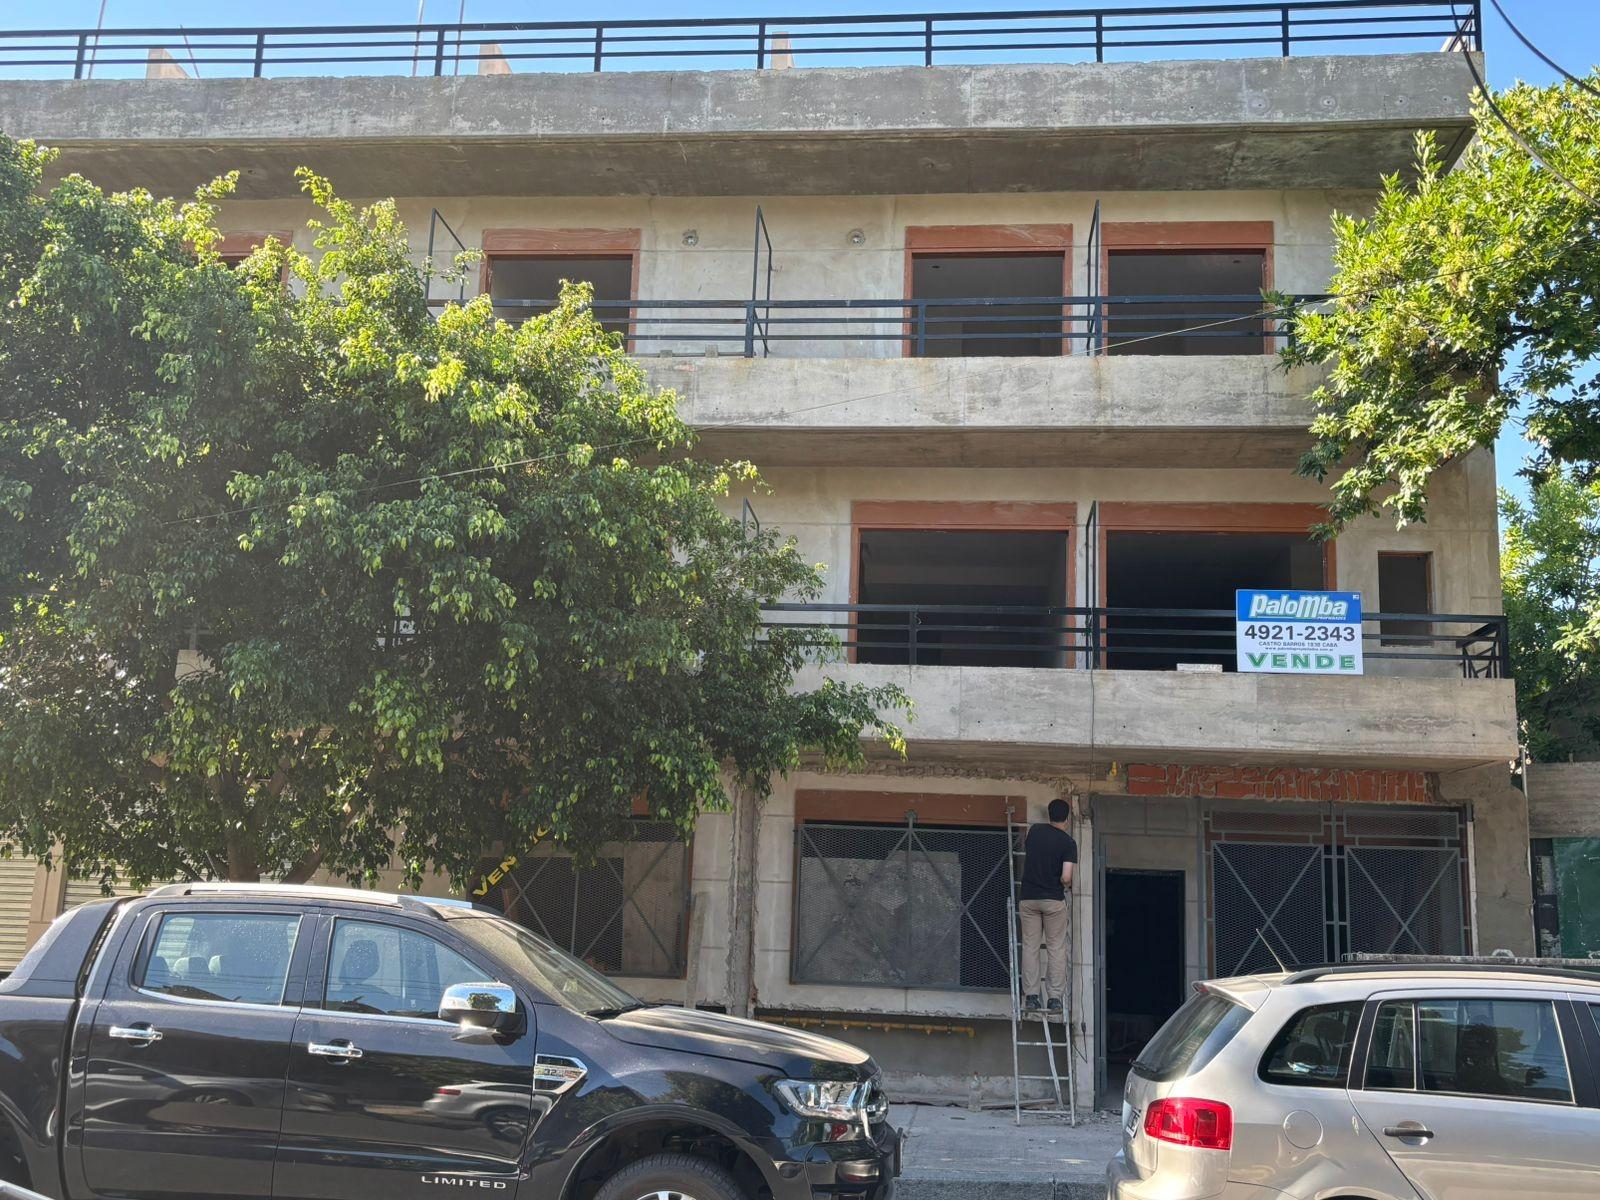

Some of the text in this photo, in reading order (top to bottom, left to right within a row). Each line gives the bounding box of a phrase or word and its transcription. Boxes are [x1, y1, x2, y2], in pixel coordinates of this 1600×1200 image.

[1249, 594, 1348, 618] Palomba
[1244, 624, 1356, 642] 4921-2343
[1245, 652, 1356, 670] VENDE
[421, 1176, 507, 1189] LIMITED
